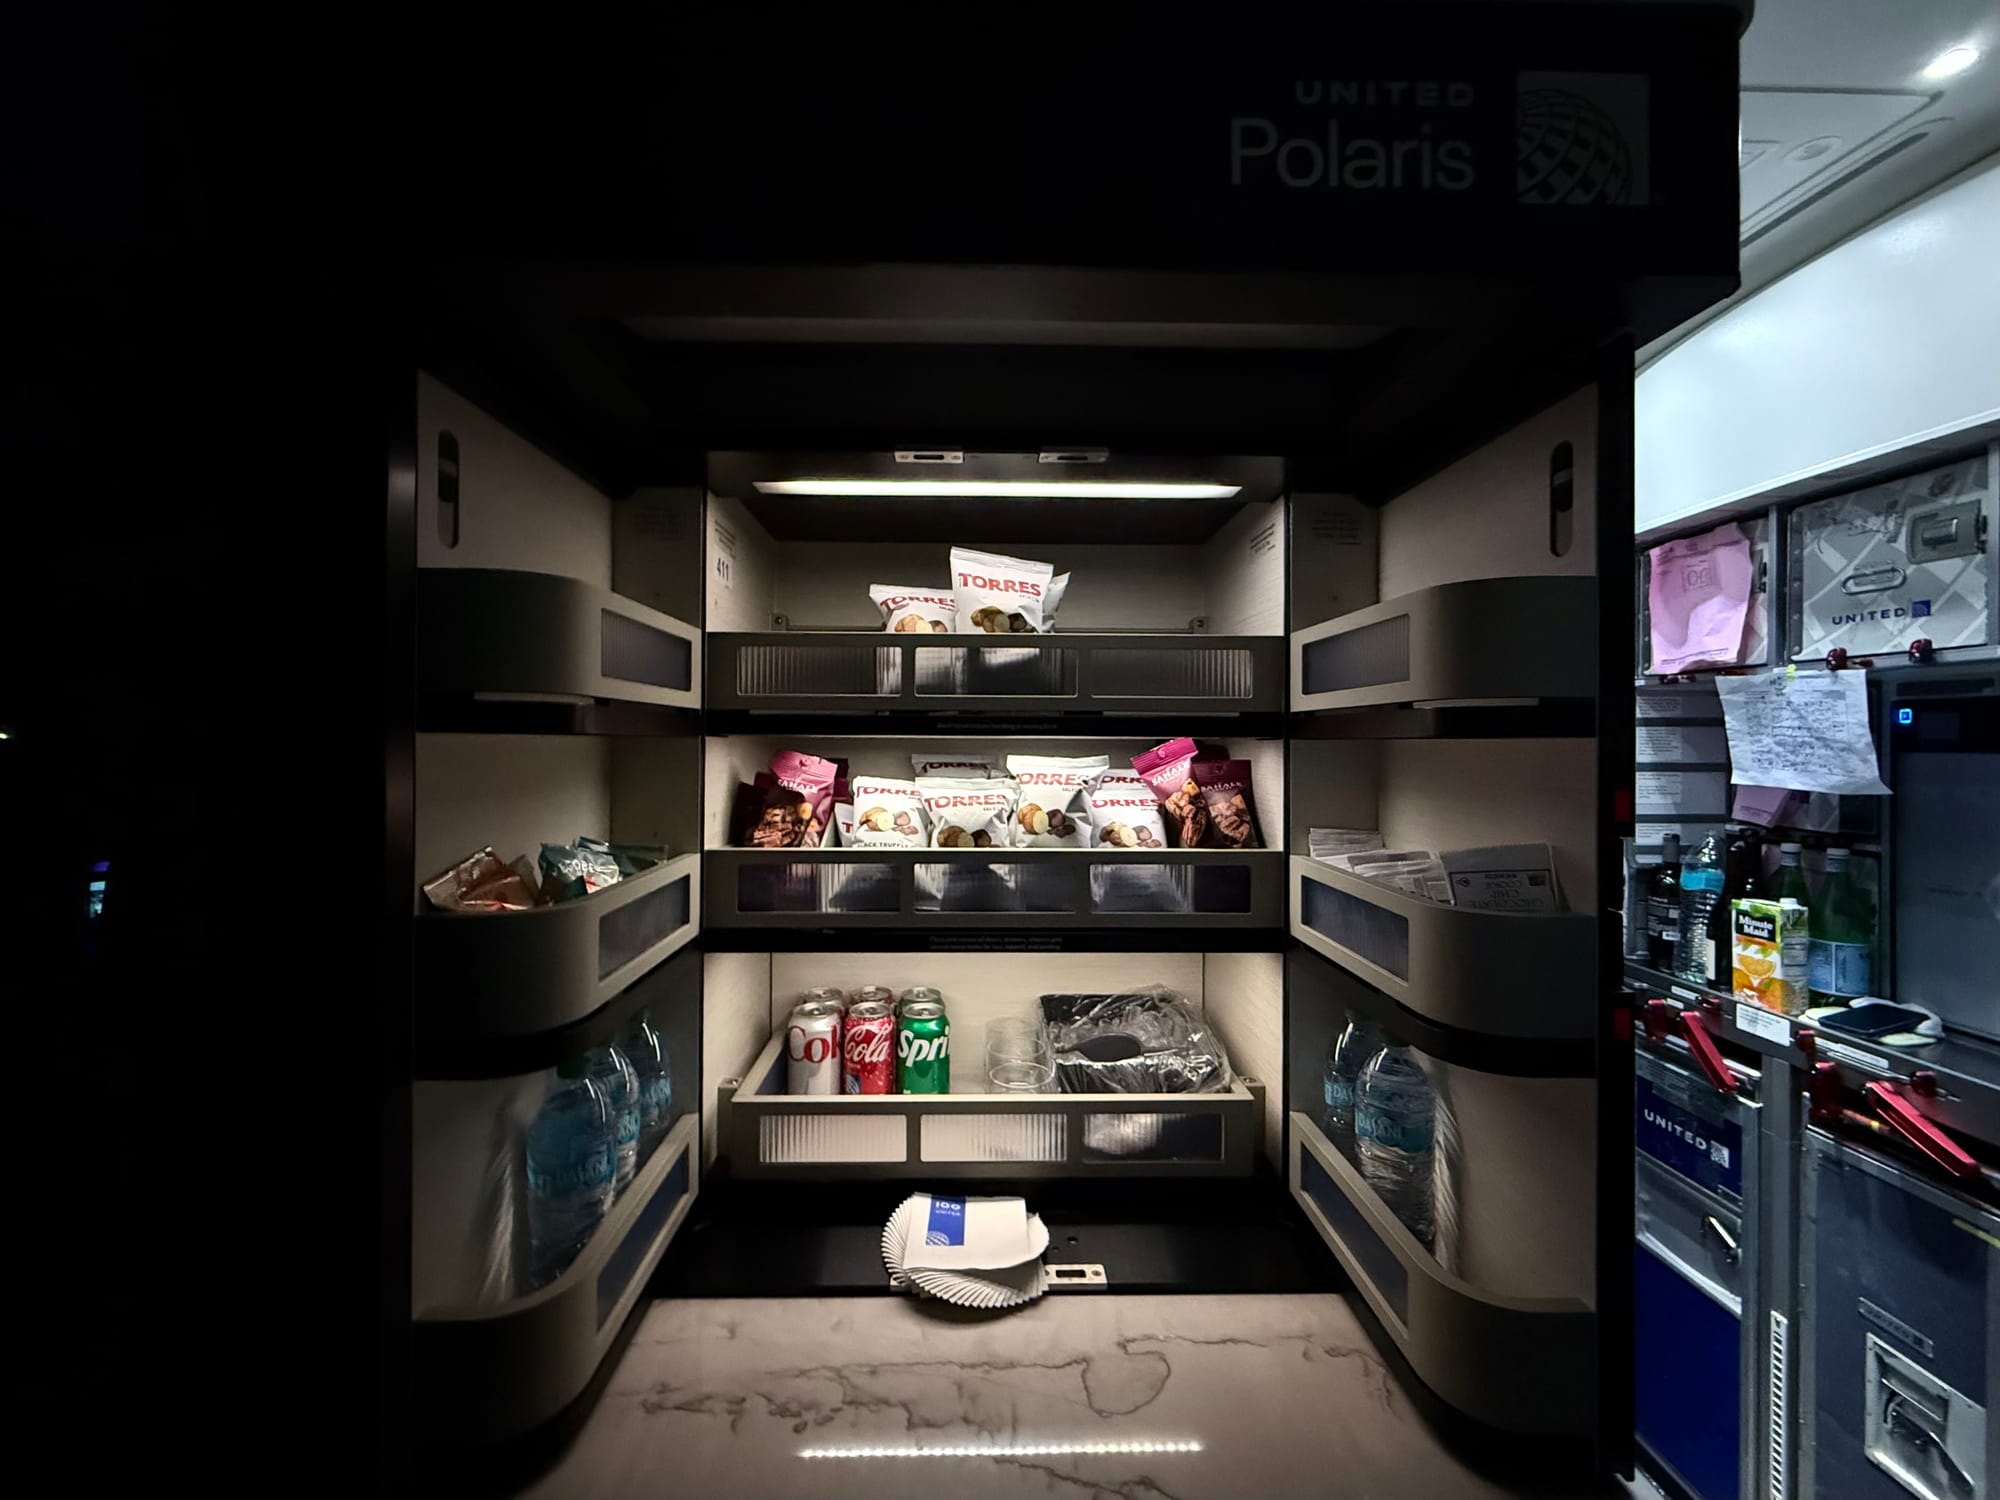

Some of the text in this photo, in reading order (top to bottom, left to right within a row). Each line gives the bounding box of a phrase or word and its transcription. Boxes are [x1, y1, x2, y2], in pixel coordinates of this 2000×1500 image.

[1295, 79, 1476, 107] UNITED
[1230, 116, 1476, 191] Polaris
[716, 557, 730, 582] 411
[958, 572, 1042, 598] TORRES
[1831, 606, 1907, 626] UNITED
[1015, 772, 1090, 787] ORRES
[1100, 774, 1146, 785] ORR
[856, 785, 922, 799] TORRE
[923, 793, 1007, 813] TORRES
[1091, 798, 1161, 809] ORRES
[1738, 914, 1774, 930] Minute
[1743, 924, 1769, 938] Maid
[845, 1021, 892, 1064] Cola
[898, 1022, 949, 1068] Spri
[1643, 1108, 1708, 1152] UNITED
[935, 1200, 962, 1211] 100
